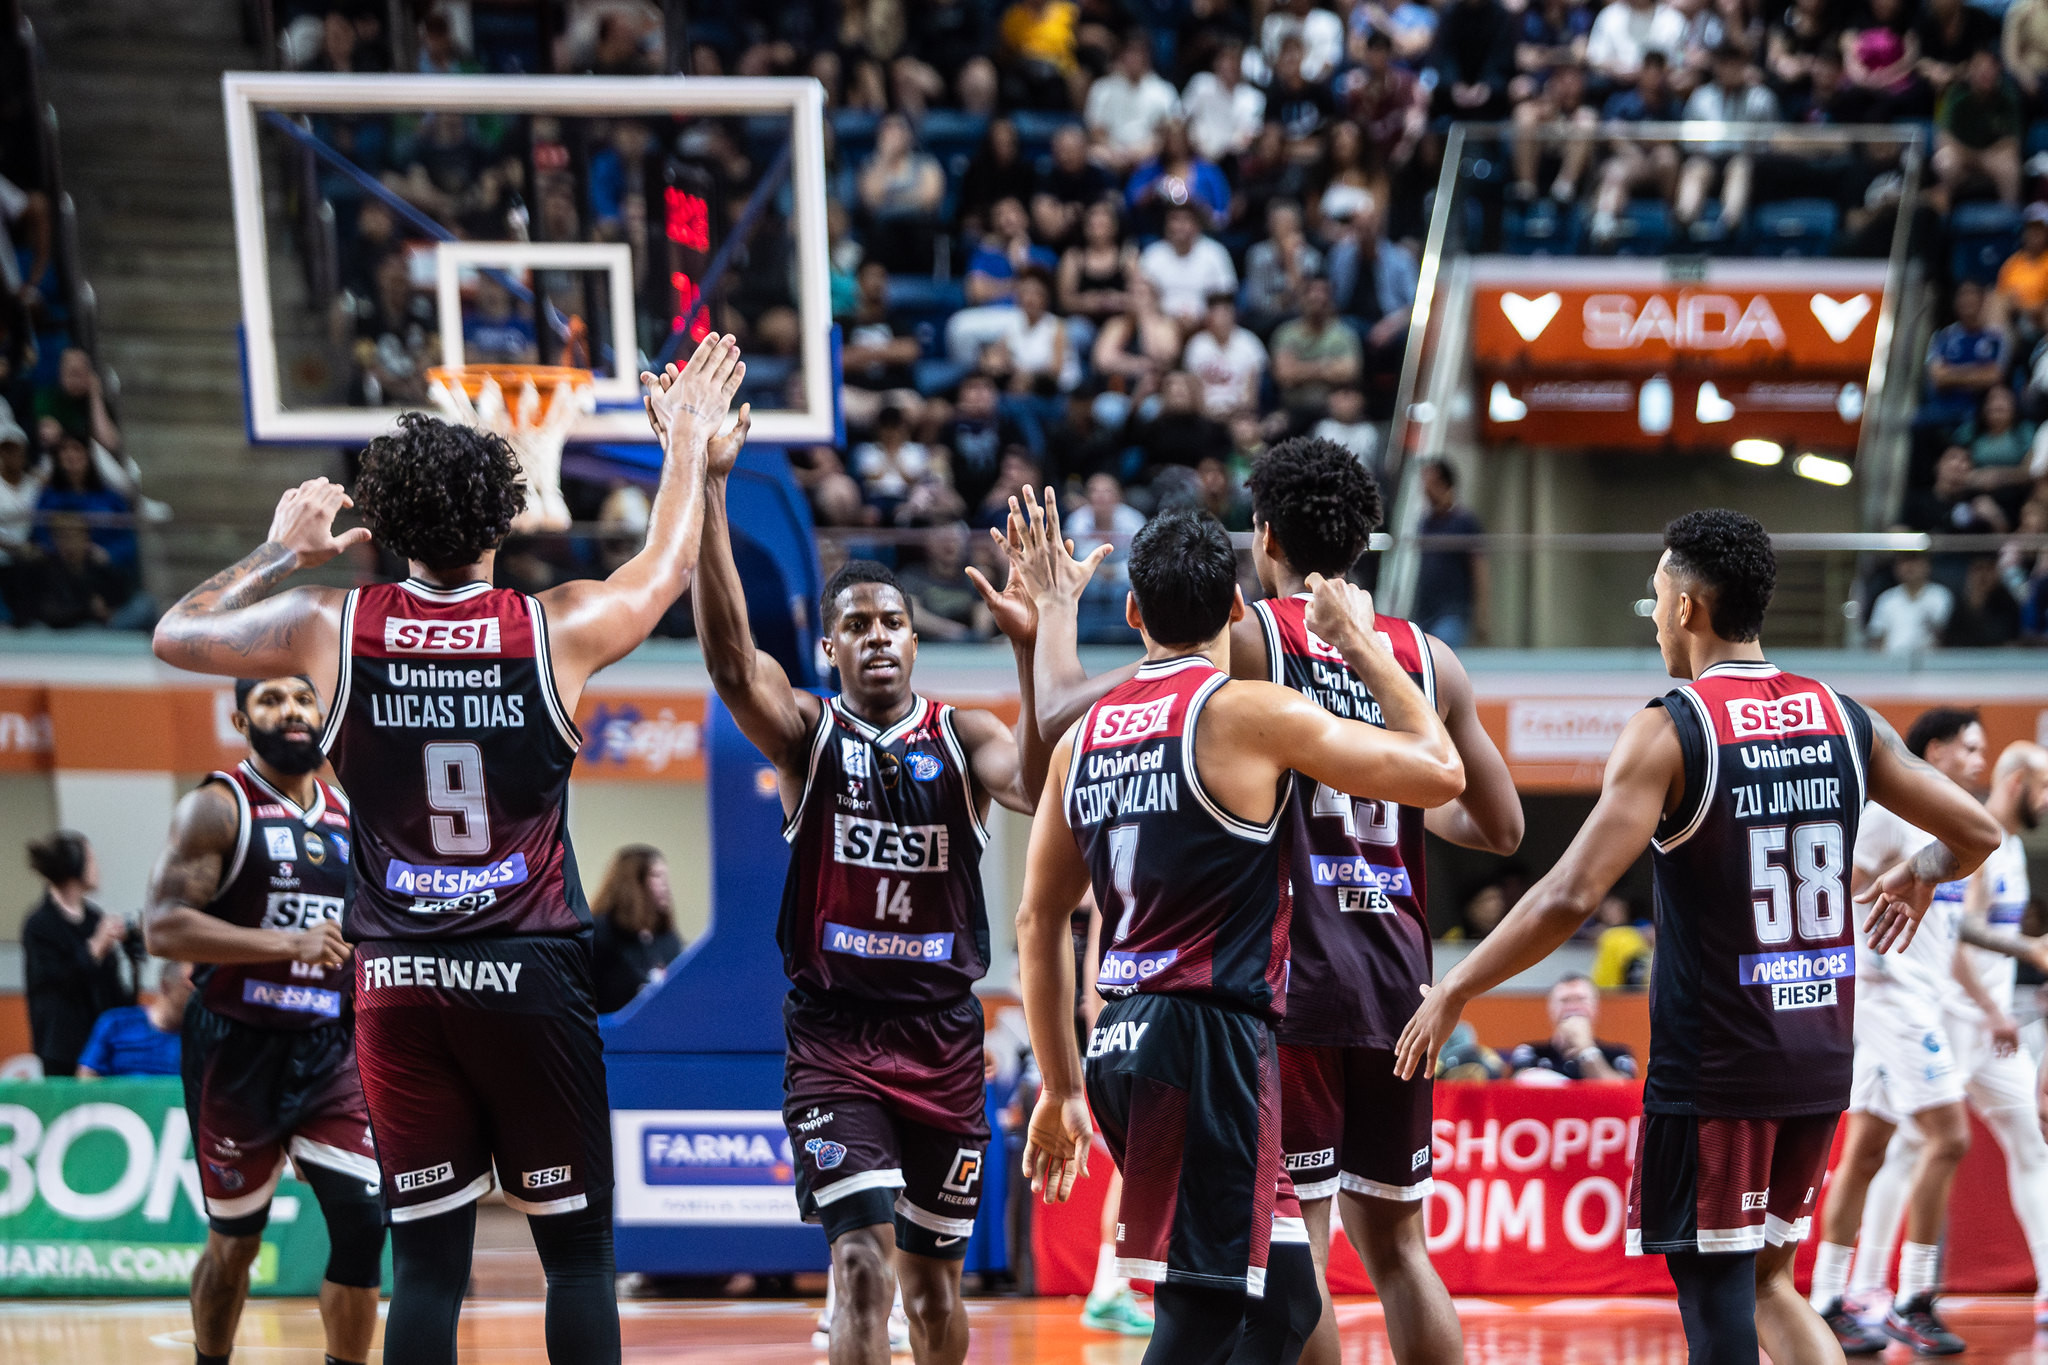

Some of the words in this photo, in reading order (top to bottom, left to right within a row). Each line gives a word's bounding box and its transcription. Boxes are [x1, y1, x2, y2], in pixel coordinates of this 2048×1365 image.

[395, 624, 489, 650] SESI
[388, 663, 501, 688] Unimed
[1312, 662, 1374, 697] Unim
[371, 693, 456, 728] LUCAS
[463, 694, 525, 728] DIAS
[1100, 701, 1168, 739] SESI
[1355, 697, 1385, 724] MAR
[1741, 697, 1814, 730] SESI
[1088, 744, 1165, 779] Unimed
[1740, 740, 1833, 769] Unimed
[423, 741, 491, 855] 9
[1732, 783, 1762, 819] ZU
[1769, 777, 1840, 815] JUNIOR
[843, 825, 939, 867] SESI
[1748, 822, 1845, 944] 58
[875, 877, 913, 924] 14
[833, 931, 944, 957] Netshoes
[363, 955, 522, 993] FREEWAY
[1751, 953, 1847, 983] Netshoes
[1777, 983, 1832, 1006] FIESP
[797, 1111, 834, 1133] Topper
[648, 1133, 776, 1166] FARMA
[1285, 1151, 1331, 1168] FIESP
[400, 1166, 449, 1190] FIESP
[527, 1168, 567, 1187] SESI
[1423, 1178, 1545, 1253] DIM
[1562, 1175, 1633, 1254] O
